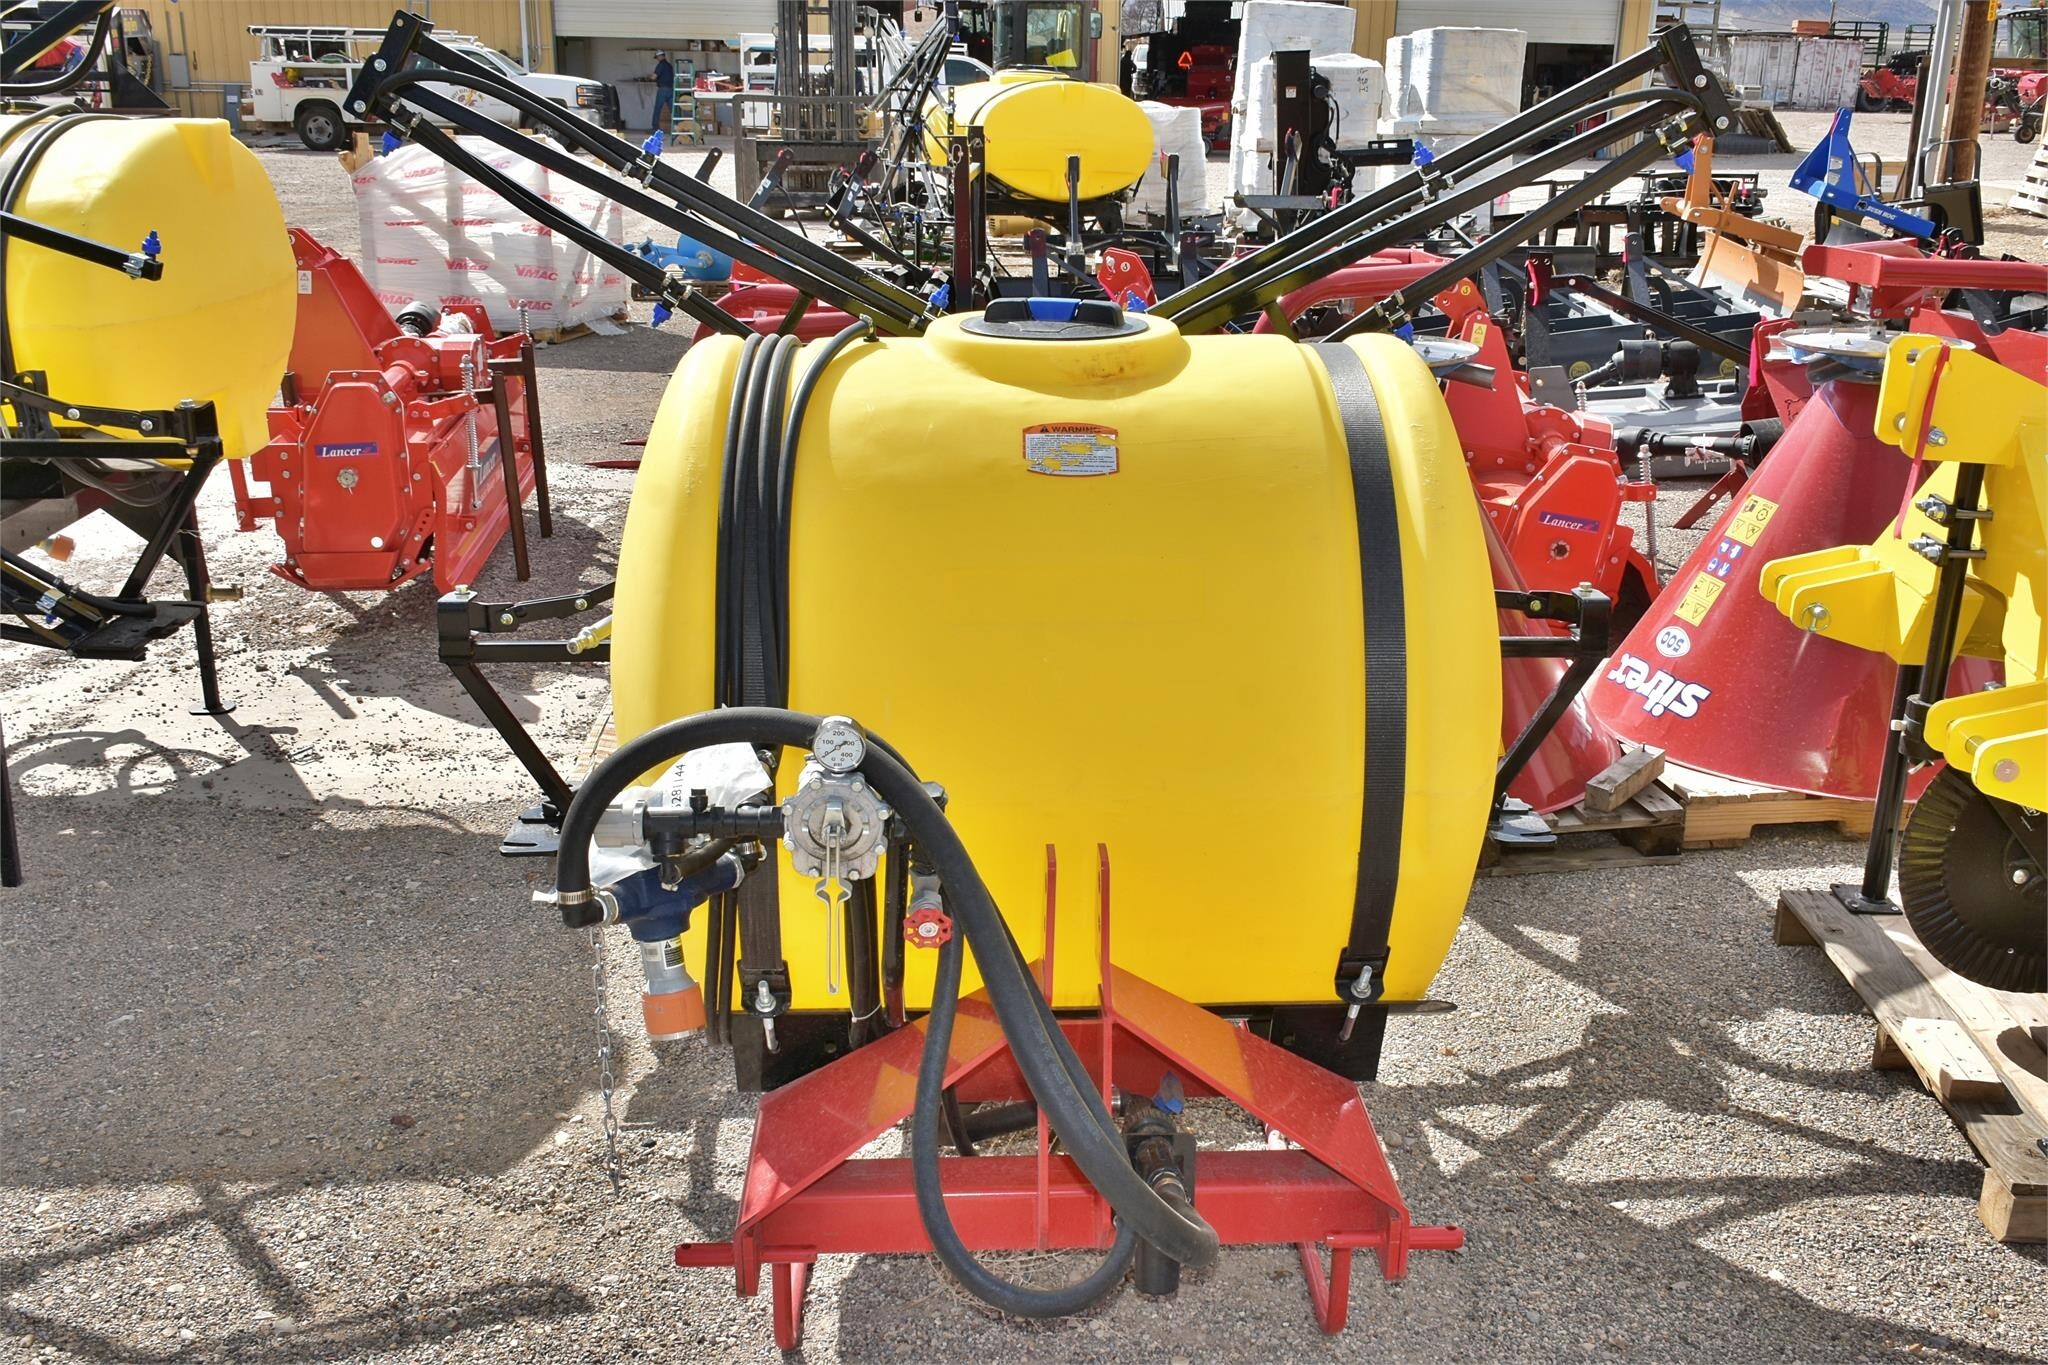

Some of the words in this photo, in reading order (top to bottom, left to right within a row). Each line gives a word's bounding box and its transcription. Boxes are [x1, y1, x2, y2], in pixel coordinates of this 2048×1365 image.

[515, 264, 559, 281] VMAC
[322, 446, 362, 457] Lancer
[1543, 514, 1583, 530] Lancer
[1660, 631, 1685, 652] 500
